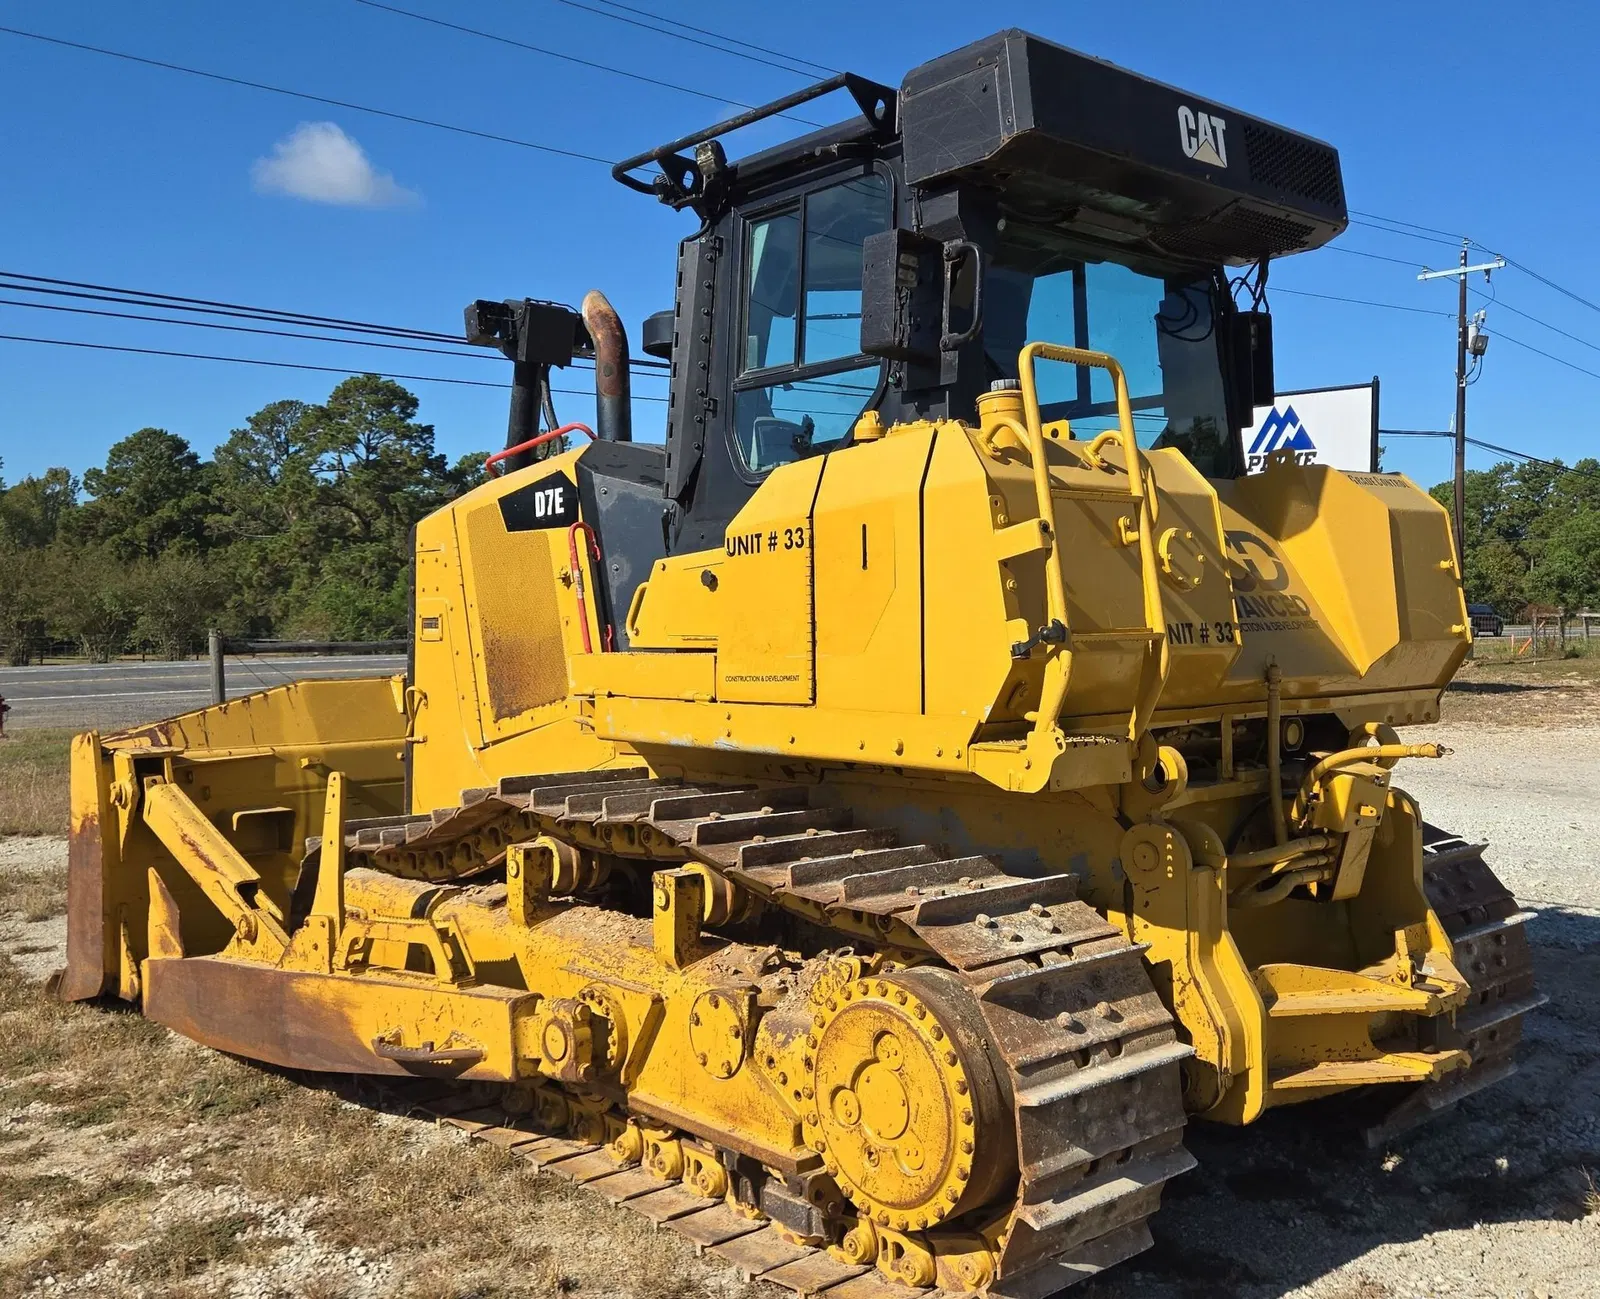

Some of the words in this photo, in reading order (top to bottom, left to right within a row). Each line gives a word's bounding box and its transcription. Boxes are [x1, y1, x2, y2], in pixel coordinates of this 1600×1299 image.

[1177, 105, 1227, 168] CAT
[535, 487, 565, 518] D7E
[726, 533, 762, 557] UNIT
[768, 531, 778, 552] #
[784, 527, 805, 550] 33
[1167, 622, 1194, 645] NIT
[1200, 622, 1210, 644] #
[1215, 621, 1235, 643] 33
[761, 674, 765, 682] &
[765, 674, 799, 682] DEVELOPMENT
